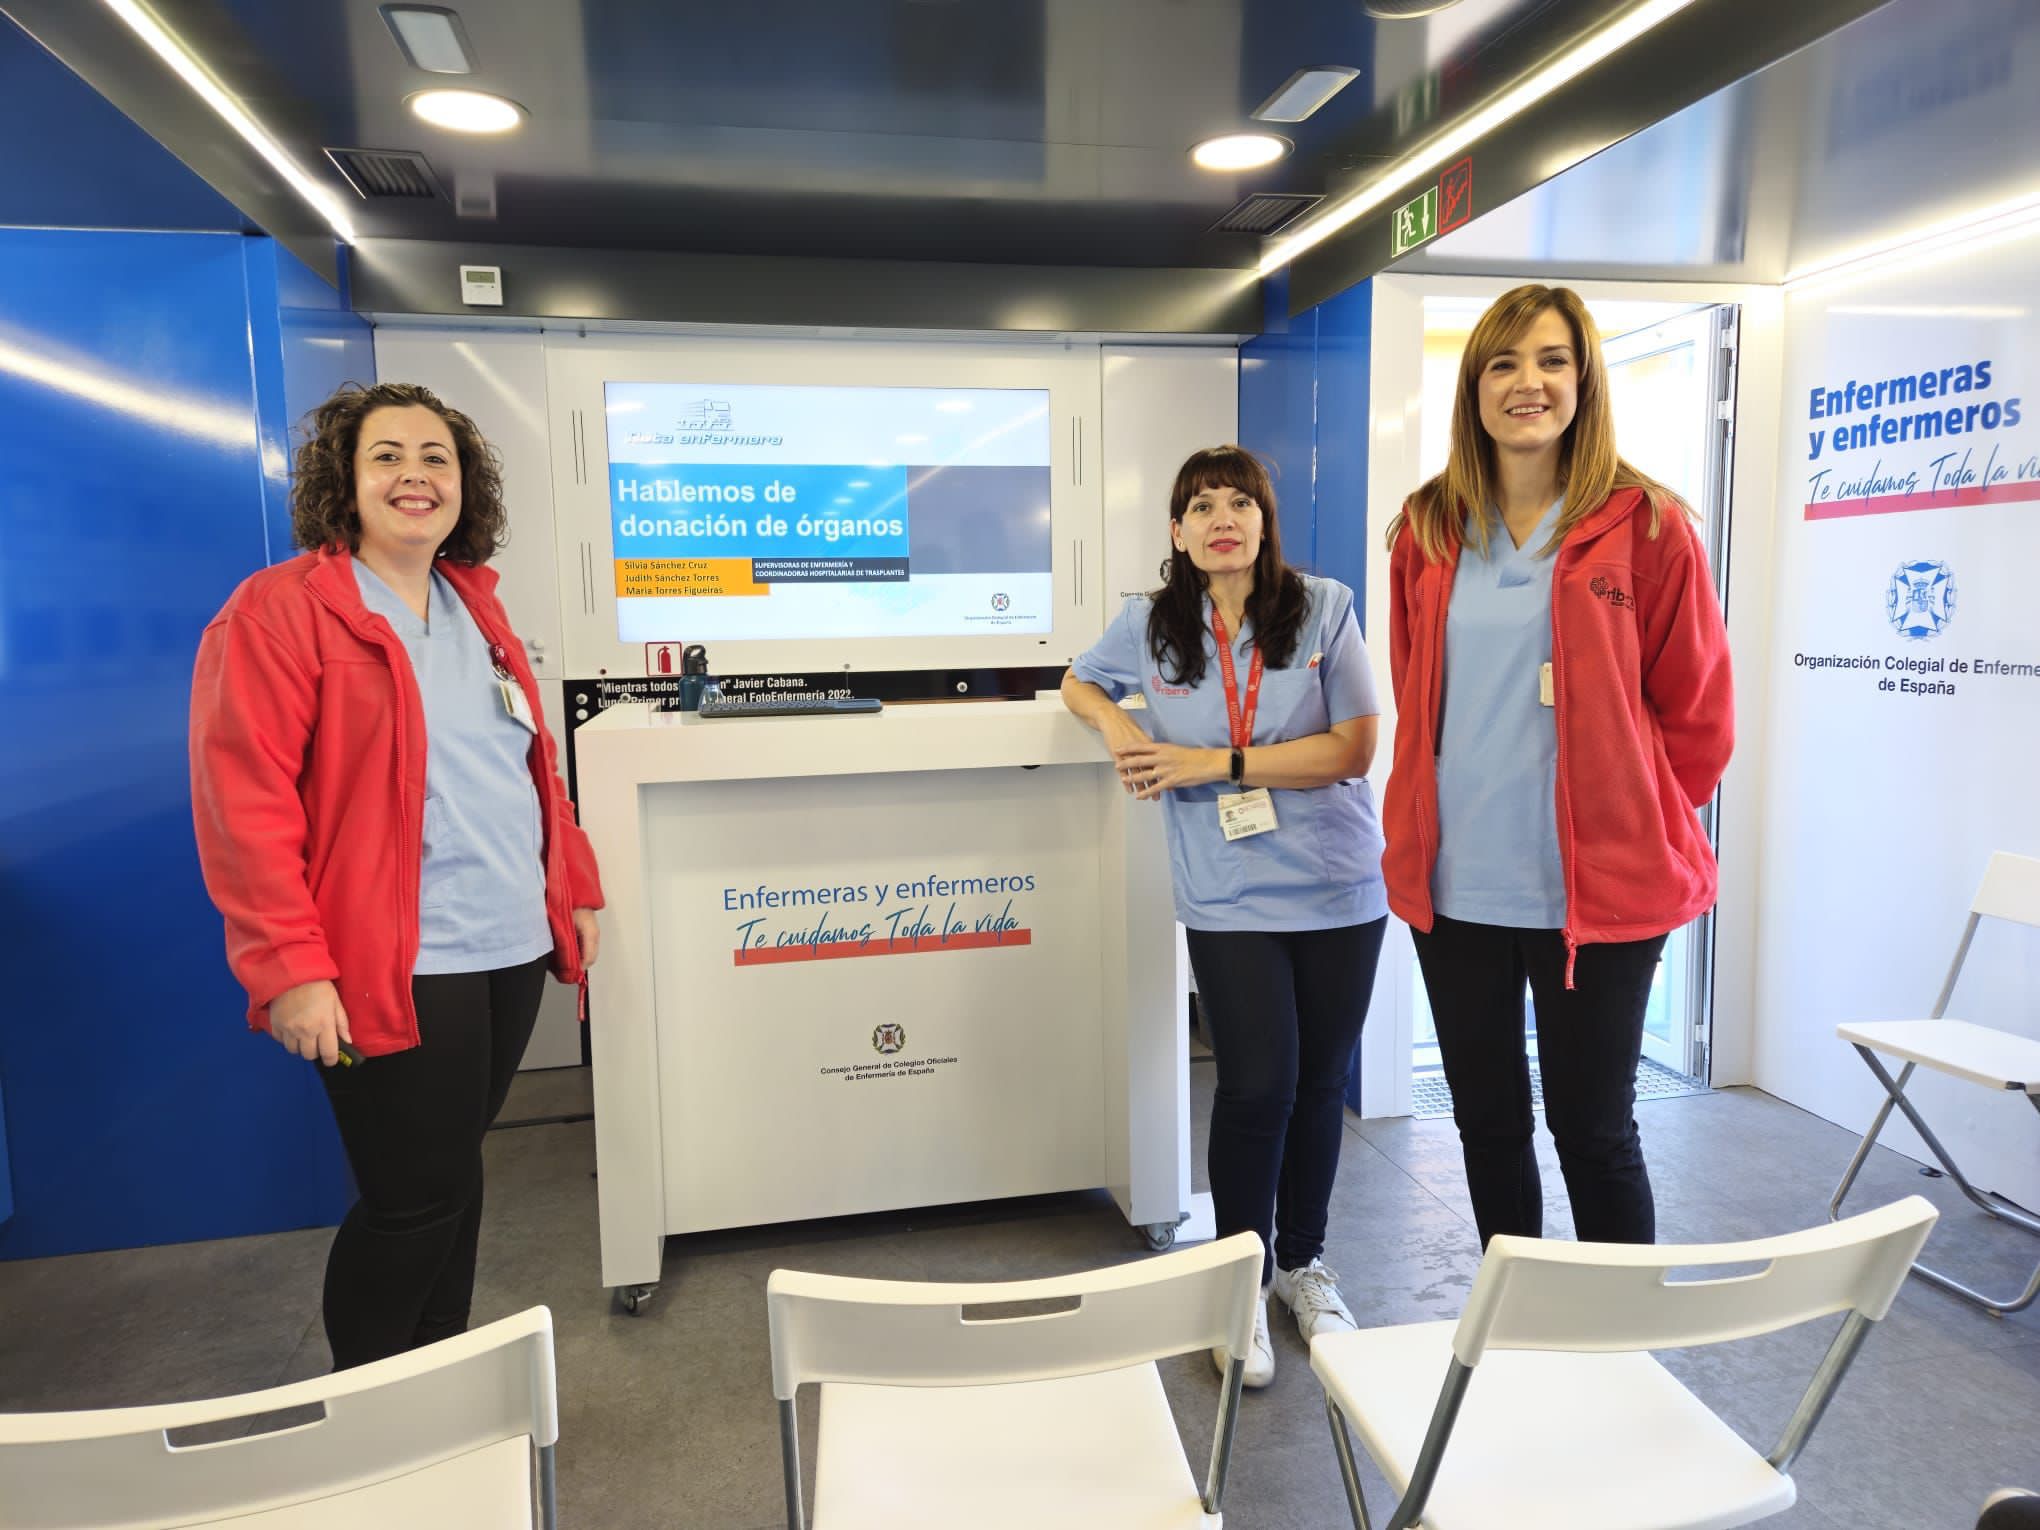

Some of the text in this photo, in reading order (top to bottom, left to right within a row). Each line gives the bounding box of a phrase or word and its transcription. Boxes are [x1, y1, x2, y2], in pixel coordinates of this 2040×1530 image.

[1809, 360, 1992, 419] Enfermeras
[680, 432, 784, 446] enfermera
[1808, 398, 2022, 460] y enfermeros
[1808, 469, 1833, 507] Te
[1837, 459, 1920, 506] cuidamos
[1929, 448, 1977, 498] Toda
[618, 480, 796, 502] Hablemos de
[620, 514, 903, 541] donación de órganos
[624, 561, 708, 570] Silvia Sánchez Cruz
[626, 573, 720, 583] Judith Sánchez Torres
[655, 586, 682, 594] Torres
[684, 585, 724, 595] Figueiras
[1794, 653, 1880, 672] Organización
[1885, 655, 1944, 675] Colegial
[1949, 658, 1968, 673] de
[650, 682, 678, 691] todos
[733, 679, 763, 689] Javier
[767, 678, 807, 688] Cabana.
[1878, 677, 1955, 698] de España
[724, 875, 1035, 911] Enfermeras y enfermeros
[736, 918, 767, 960] Te
[776, 911, 877, 955] cuidamos
[885, 904, 936, 949] Toda
[975, 899, 1019, 944] vida
[820, 1067, 851, 1075] Consejo
[853, 1063, 881, 1072] General
[893, 1059, 925, 1069] Colegios
[926, 1056, 957, 1065] Oficiales
[844, 1073, 854, 1081] de
[856, 1070, 896, 1080] Enfermería
[908, 1067, 935, 1075] España
